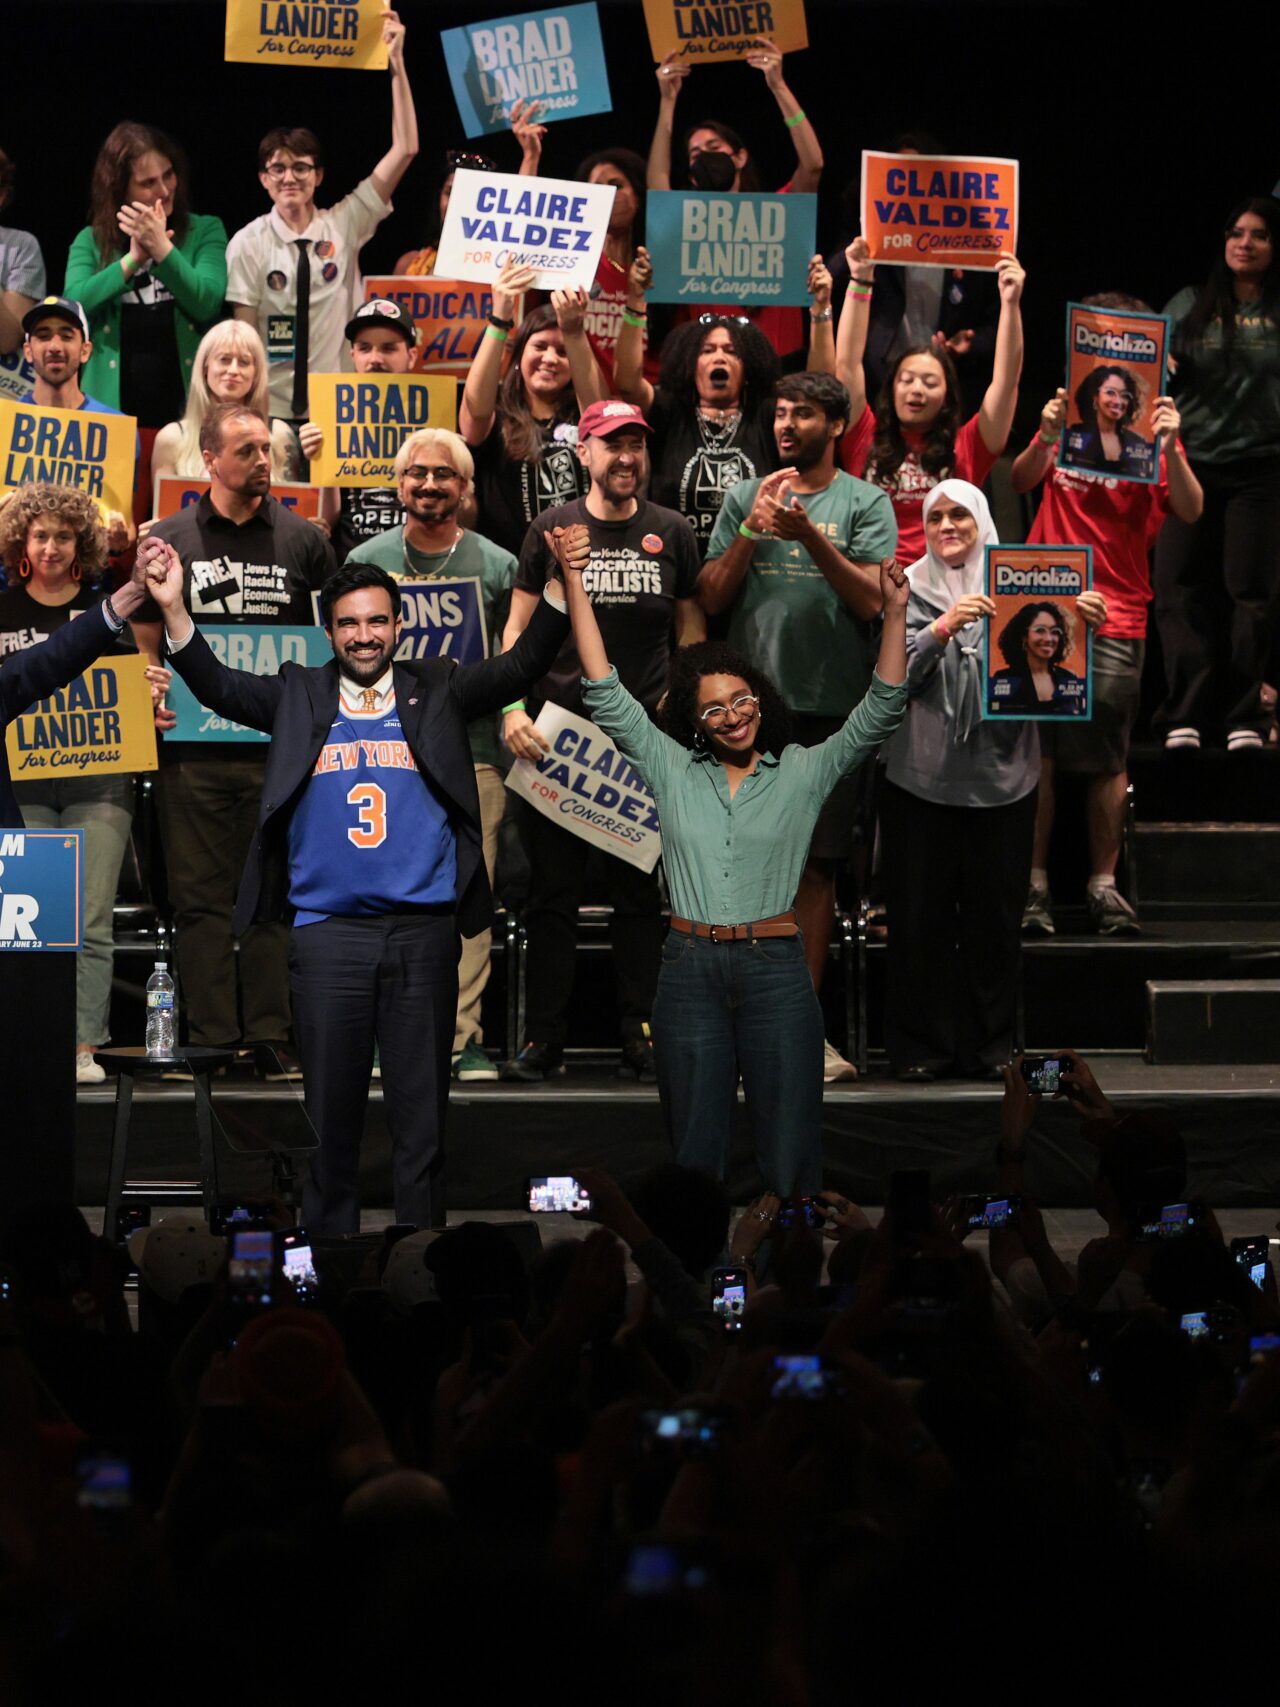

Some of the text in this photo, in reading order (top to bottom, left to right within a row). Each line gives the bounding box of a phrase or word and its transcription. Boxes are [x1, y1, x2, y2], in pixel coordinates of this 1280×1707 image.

[260, 2, 358, 40] LANDER
[675, 3, 774, 39] LANDER
[257, 38, 355, 60] for Congress
[472, 16, 571, 72] BRAD
[680, 39, 706, 56] for
[480, 58, 577, 106] LANDER
[886, 168, 1000, 200] CLAIRE
[475, 186, 587, 224] CLAIRE
[875, 201, 1010, 230] VALDEZ
[460, 217, 593, 252] VALDEZ
[681, 199, 785, 243] BRAD
[883, 232, 1003, 252] FOR CONGRESS
[463, 250, 492, 264] FOR
[680, 242, 784, 278] LANDER
[679, 277, 781, 300] for Congress
[1076, 325, 1156, 354] Darializa
[335, 384, 428, 425] BRAD
[10, 412, 108, 463] BRAD
[336, 460, 396, 479] for Cong
[244, 563, 287, 577] Jews For
[244, 576, 285, 590] Racial &
[582, 571, 662, 594] CIALISTS
[996, 566, 1081, 587] Darializa
[243, 603, 279, 616] Justice
[244, 589, 291, 604] Economic
[16, 710, 121, 751] LANDER
[19, 748, 121, 770] for Congress
[553, 727, 652, 801] CLAIR
[347, 783, 387, 848] 3
[531, 780, 646, 844] FOR CONGRESS
[12, 940, 30, 948] JUNE
